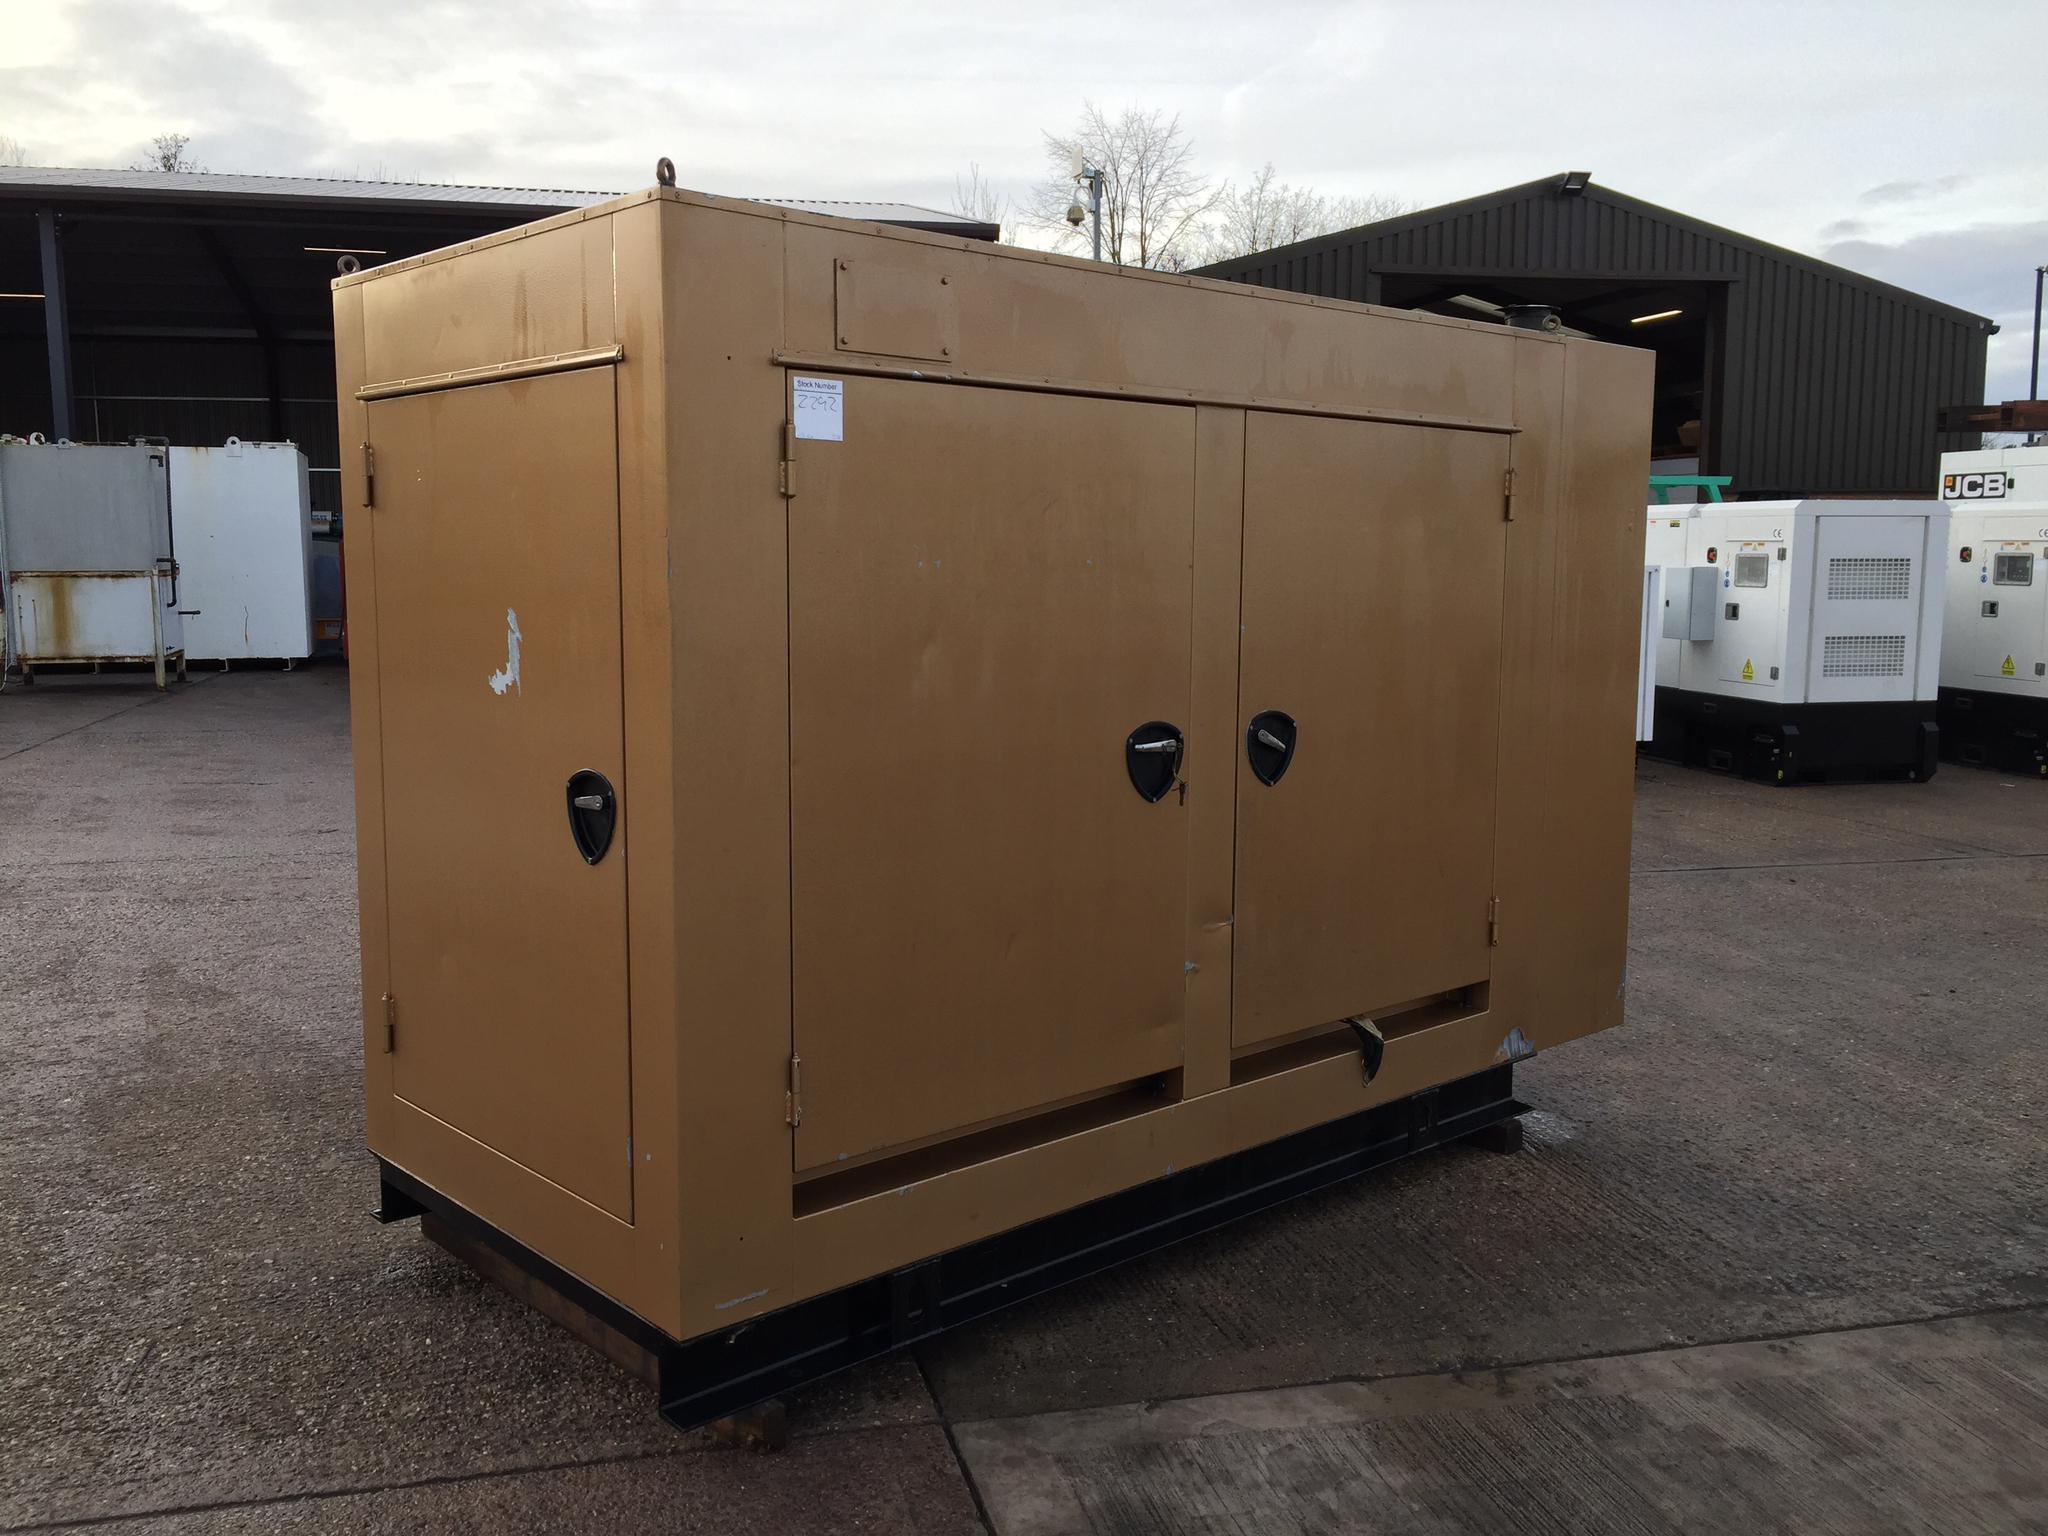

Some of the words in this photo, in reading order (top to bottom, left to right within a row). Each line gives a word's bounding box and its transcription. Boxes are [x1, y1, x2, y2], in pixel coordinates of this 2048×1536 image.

[797, 380, 813, 388] Stock
[814, 382, 837, 390] Number
[1944, 473, 2005, 498] JCB
